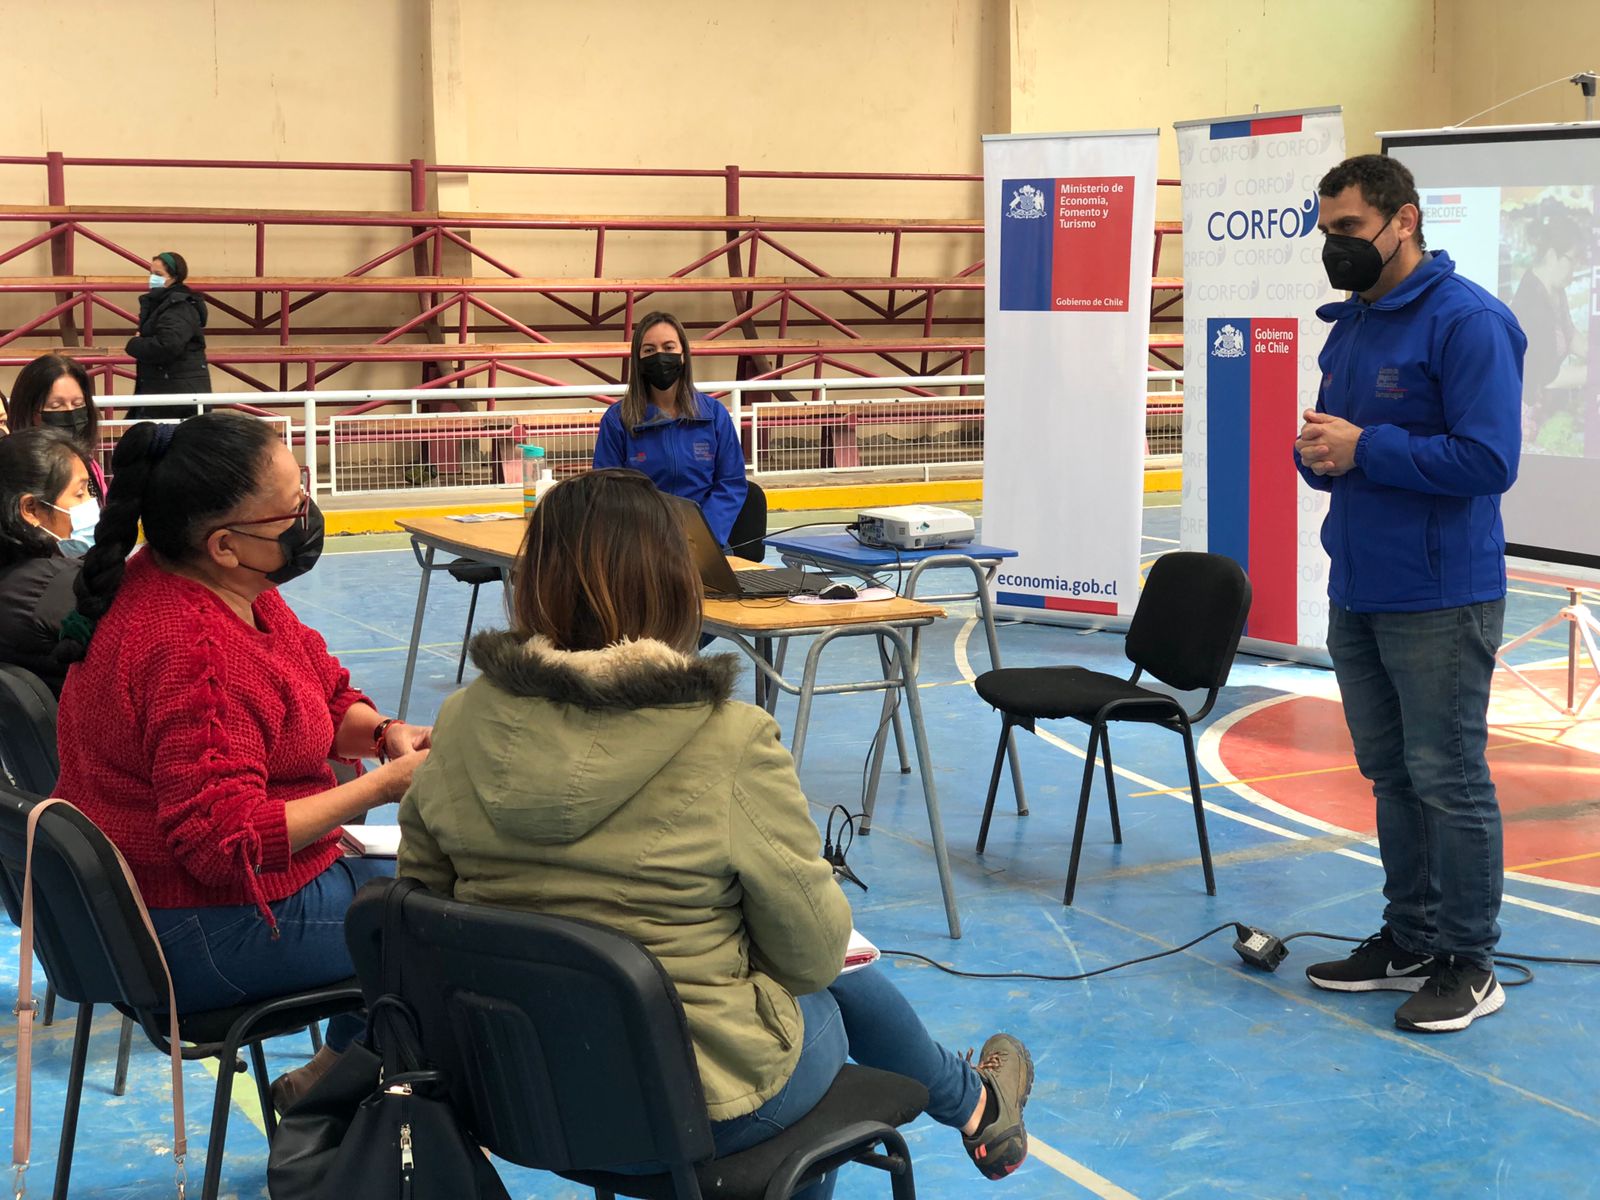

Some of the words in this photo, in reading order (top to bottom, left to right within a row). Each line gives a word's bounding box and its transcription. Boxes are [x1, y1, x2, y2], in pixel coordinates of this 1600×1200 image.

[1200, 144, 1252, 164] CORFO
[1266, 138, 1319, 159] CORFO
[1060, 184, 1110, 194] Ministerio
[1111, 183, 1124, 193] de
[1183, 182, 1218, 200] ORFO
[1234, 177, 1286, 196] CORFO
[1060, 195, 1109, 207] Economía,
[1060, 207, 1101, 217] Fomento
[1102, 208, 1109, 219] y
[1060, 219, 1097, 229] Turismo
[1208, 207, 1299, 241] CORFO
[1183, 250, 1217, 268] ORFO
[1234, 248, 1284, 266] CORFO
[1197, 284, 1250, 301] CORFO
[1266, 283, 1316, 301] CORFO
[1056, 297, 1090, 306] Gobierno
[1092, 297, 1102, 306] de
[1103, 297, 1124, 307] Chile
[1254, 328, 1294, 340] Gobierno
[1254, 341, 1267, 354] de
[1268, 342, 1290, 354] Chile
[997, 573, 1117, 595] economia.gob.cl
